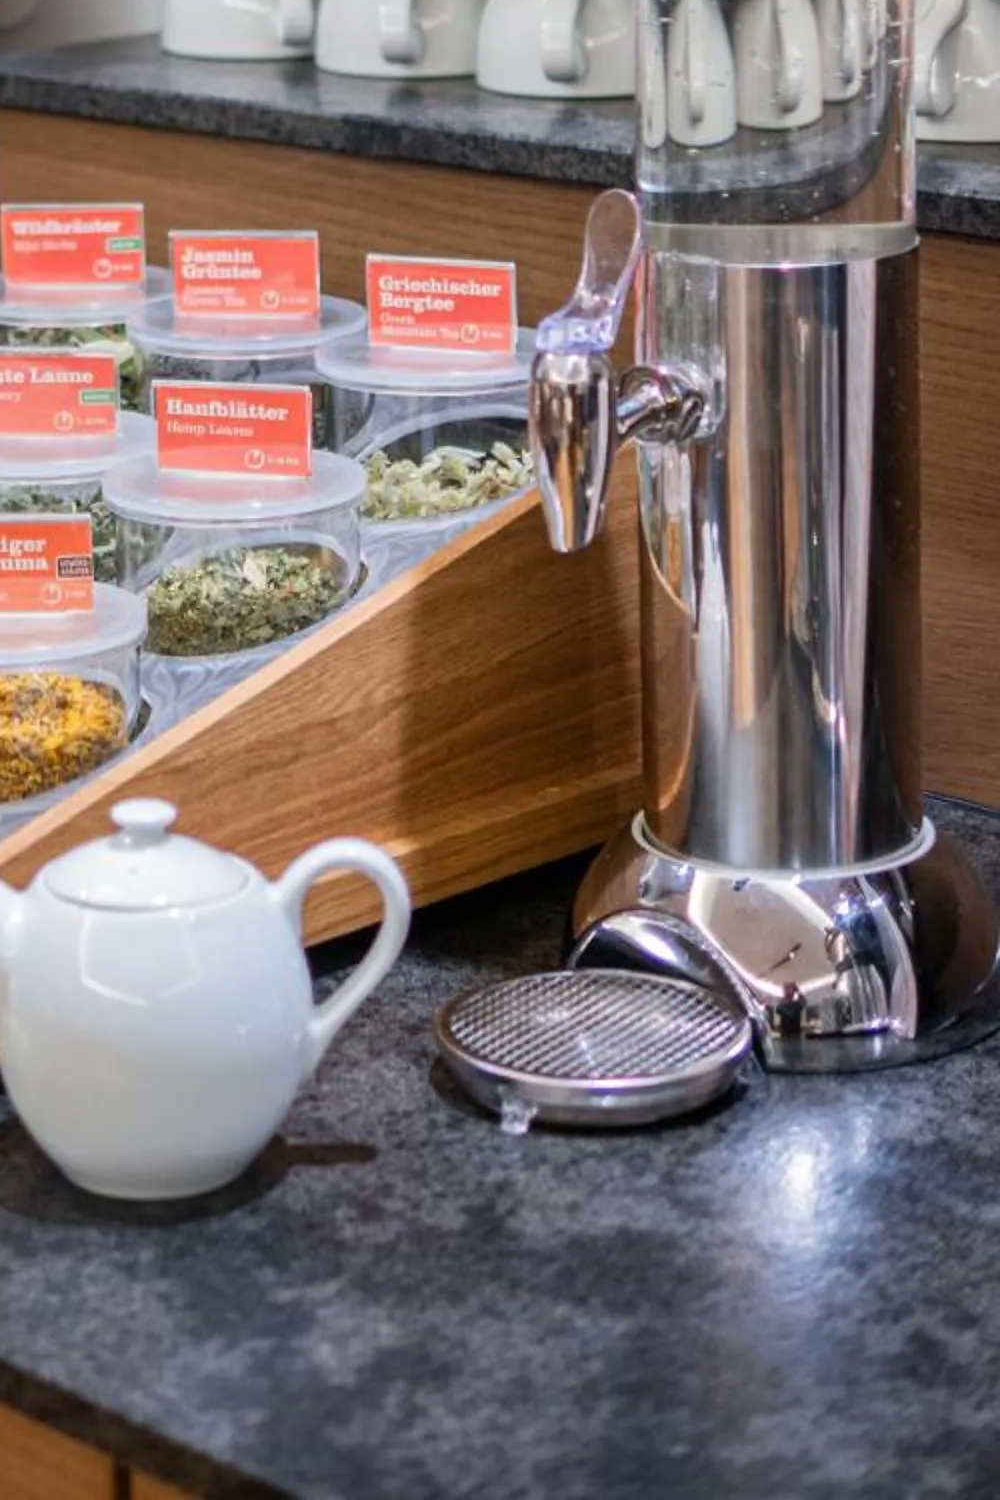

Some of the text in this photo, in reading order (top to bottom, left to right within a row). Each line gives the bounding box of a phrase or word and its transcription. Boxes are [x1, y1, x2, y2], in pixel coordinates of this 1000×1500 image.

[182, 247, 255, 264] Jasmin
[182, 263, 263, 280] Grüntee
[378, 275, 503, 297] Griechischer
[379, 291, 456, 314] Bergtee
[29, 366, 94, 384] Laune
[166, 398, 289, 421] Hanfblätter
